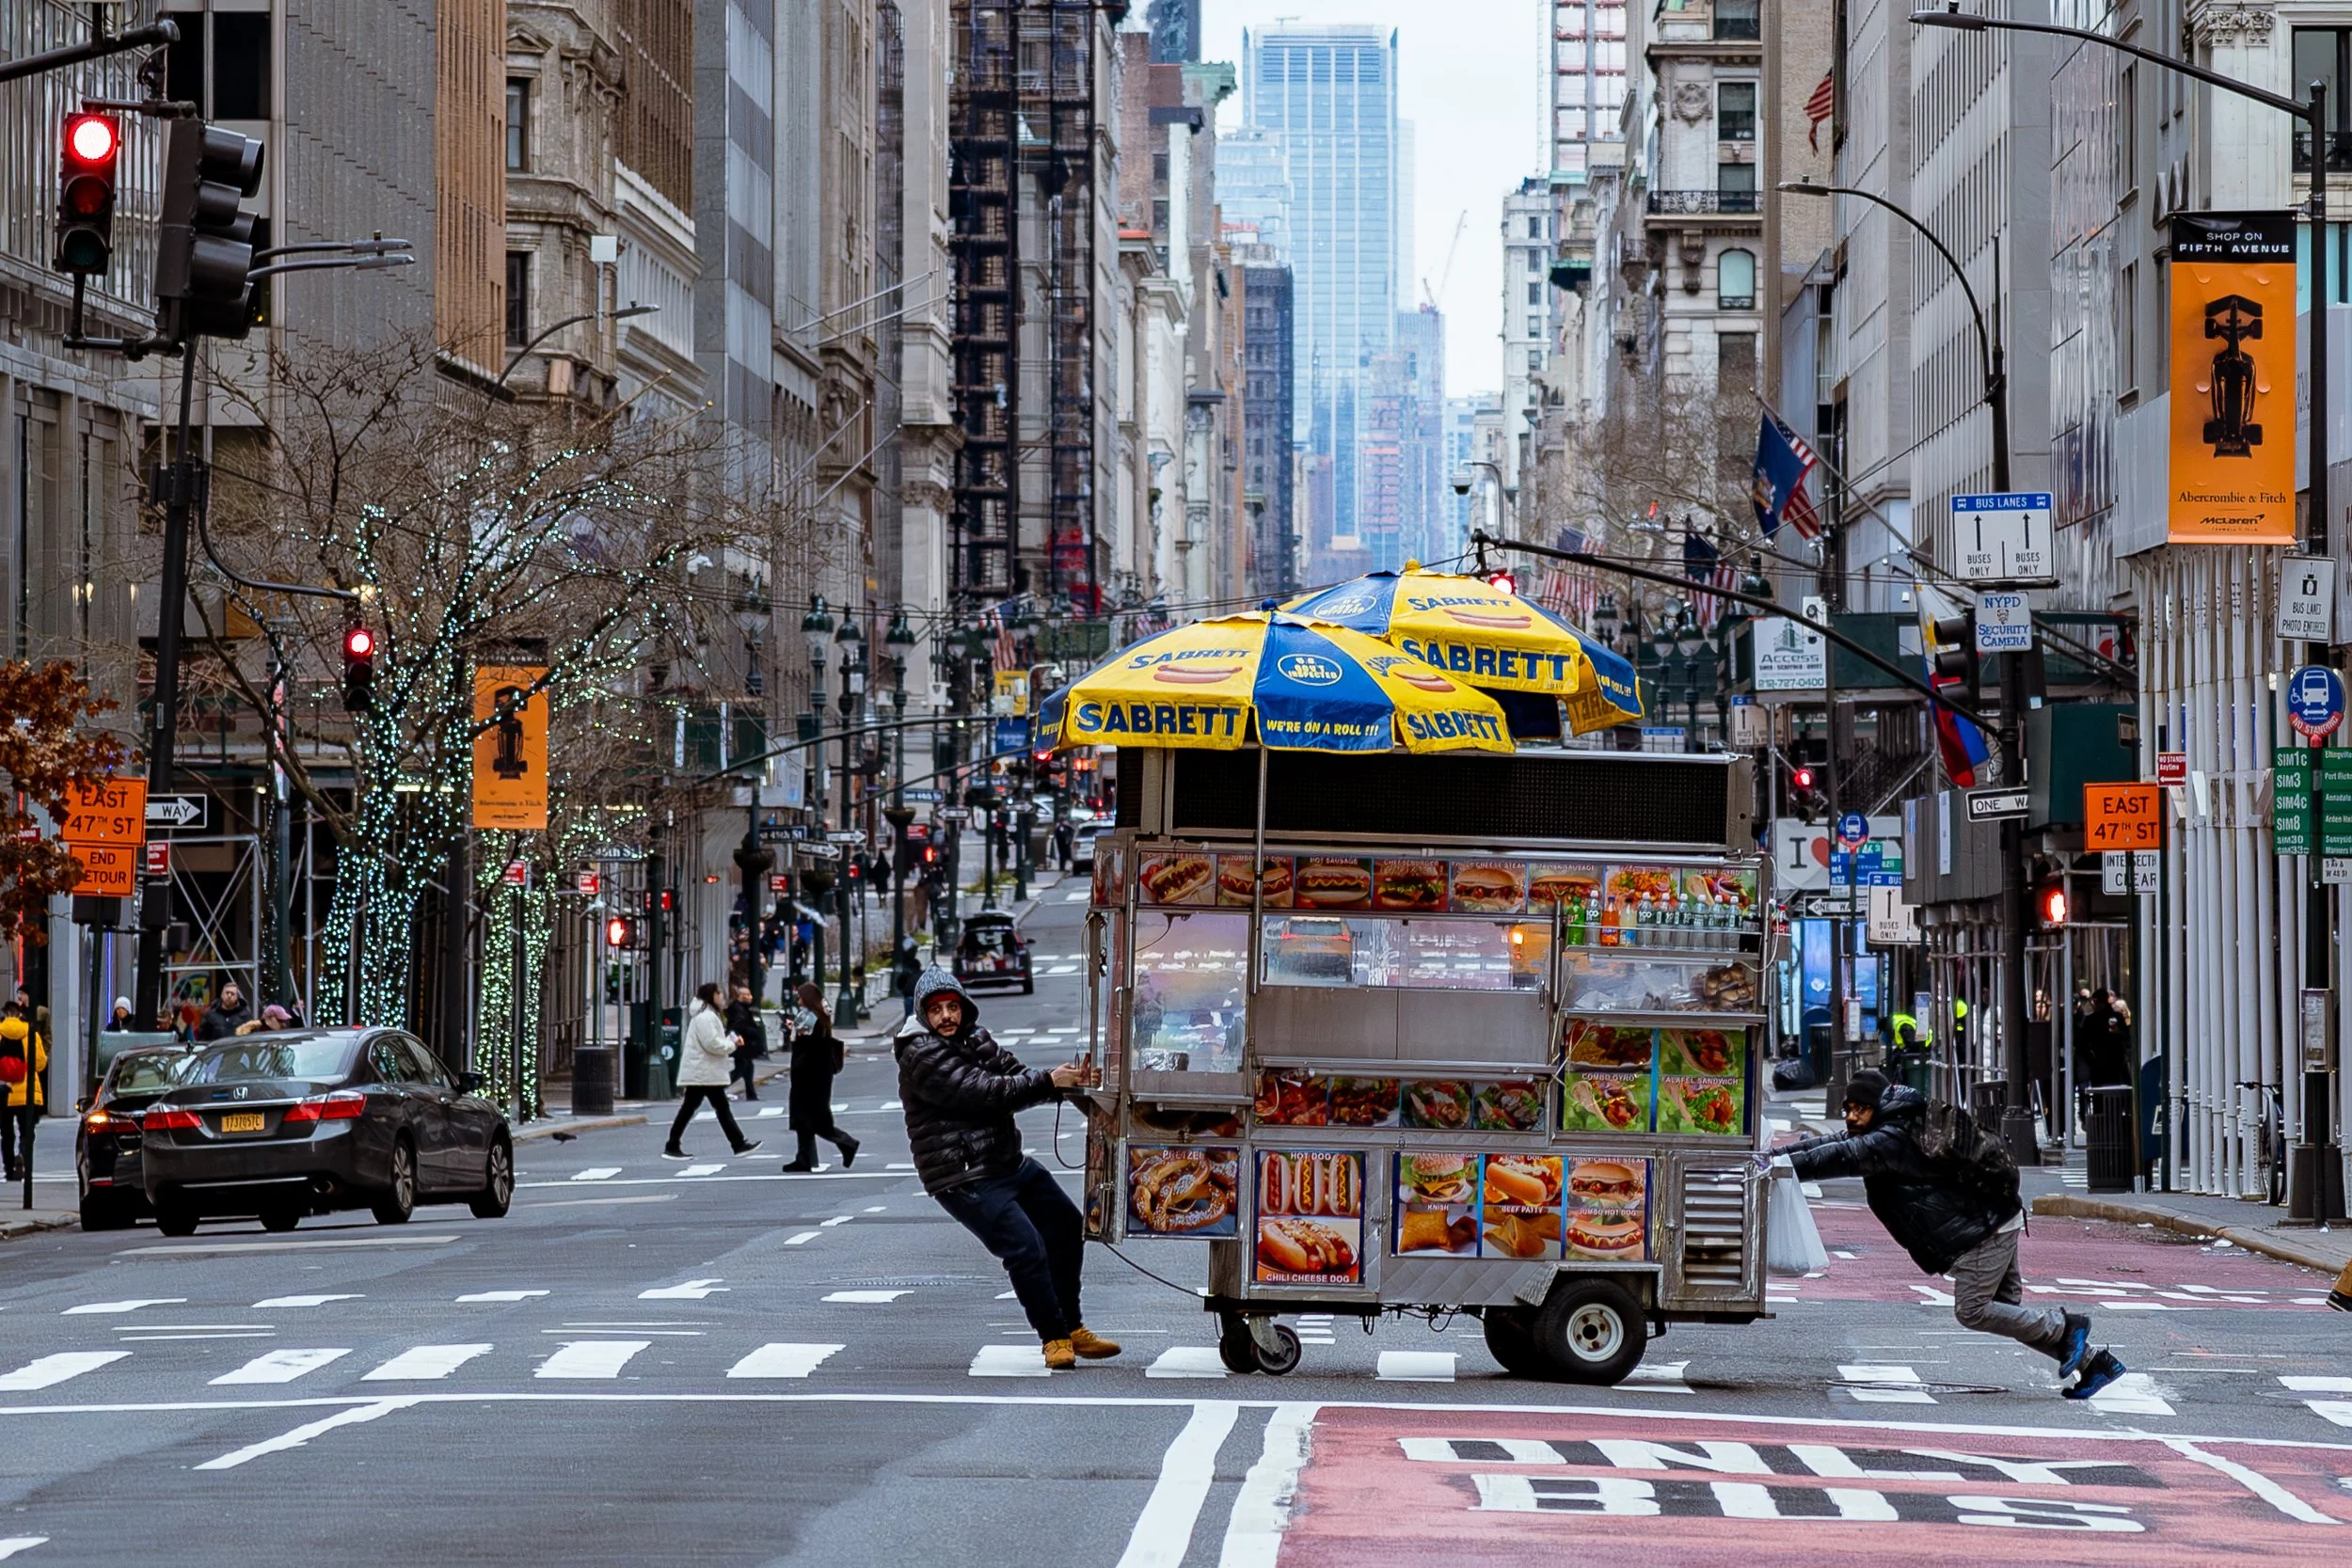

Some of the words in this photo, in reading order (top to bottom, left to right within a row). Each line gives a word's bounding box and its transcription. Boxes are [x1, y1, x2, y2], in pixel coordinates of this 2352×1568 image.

[2206, 232, 2240, 241] SHOP
[2245, 232, 2263, 241] ON
[2179, 244, 2222, 253] FIFTH
[2232, 244, 2289, 253] AVENUE
[1976, 499, 1994, 509] BUS
[1997, 497, 2027, 508] LANES
[2178, 491, 2245, 502] Abercrombie
[2260, 492, 2286, 503] Fitch
[1967, 554, 1992, 564] BUSES
[2015, 552, 2041, 562] BUSES
[1969, 566, 1991, 577] ONLY
[2018, 564, 2040, 575] ONLY
[1407, 596, 1511, 611] SABRETT
[1984, 596, 2021, 609] NYPD
[2292, 602, 2305, 614] BUS
[1978, 624, 2030, 636] SECURITY
[2282, 619, 2302, 632] PHOTO
[1980, 635, 2027, 647] CAMERA
[1128, 648, 1250, 669] SABRETT
[1401, 638, 1571, 681] SABRETT
[1074, 700, 1242, 737] SABRETT
[1266, 719, 1301, 733] WE'RE
[1304, 721, 1321, 734] ON
[1323, 722, 1331, 734] A
[1333, 723, 1362, 736] ROLL
[1365, 724, 1379, 736] !!!
[1406, 710, 1502, 742] SABRETT
[2277, 772, 2301, 788] SIM3
[81, 787, 128, 808] EAST
[162, 805, 191, 817] WAY
[1976, 799, 2002, 812] ONE
[2103, 797, 2150, 814] EAST
[113, 817, 135, 834] ST
[2277, 815, 2301, 831] SIM8
[2093, 822, 2131, 841] 47TH
[2137, 822, 2158, 839] ST
[89, 852, 116, 864] END
[84, 871, 127, 884] ETOUR
[1814, 902, 1831, 911] ONE
[1879, 921, 1899, 929] BUSES
[1881, 930, 1897, 939] ONLY
[1698, 1077, 1739, 1085] SANDWICH
[1290, 1151, 1310, 1160] HOT
[1311, 1151, 1331, 1161] DOG
[1266, 1274, 1289, 1282] CHILI
[1292, 1274, 1327, 1283] CHEESE
[1330, 1275, 1350, 1283] DOG
[1398, 1437, 2139, 1486] ONLY
[1469, 1473, 2146, 1531] BUS
